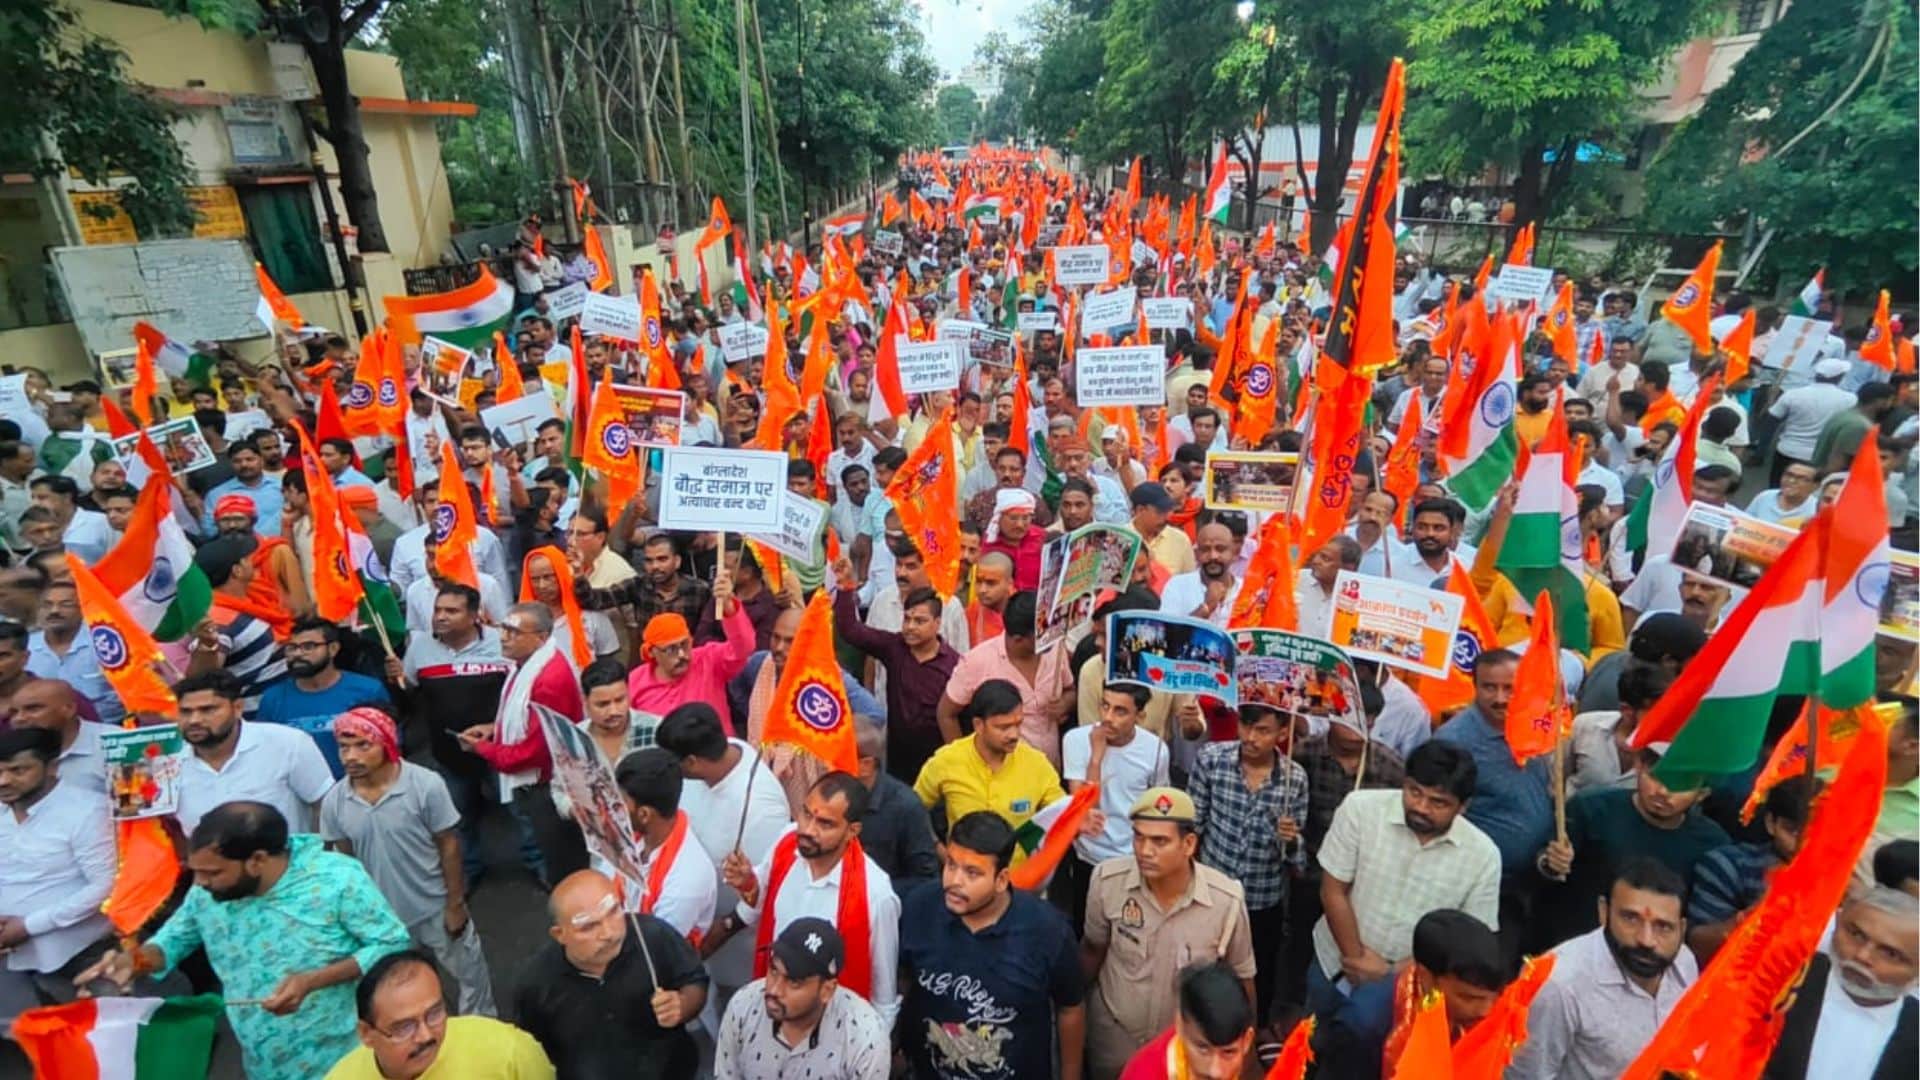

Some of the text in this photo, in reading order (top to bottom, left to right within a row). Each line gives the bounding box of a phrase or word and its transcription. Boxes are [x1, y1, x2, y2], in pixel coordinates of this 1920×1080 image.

[702, 462, 748, 479] बांग्लादेश
[674, 473, 773, 497] बौद्ध समाज पर
[679, 496, 767, 512] अत्याचार बन्द करो
[952, 974, 988, 1002] Polo
